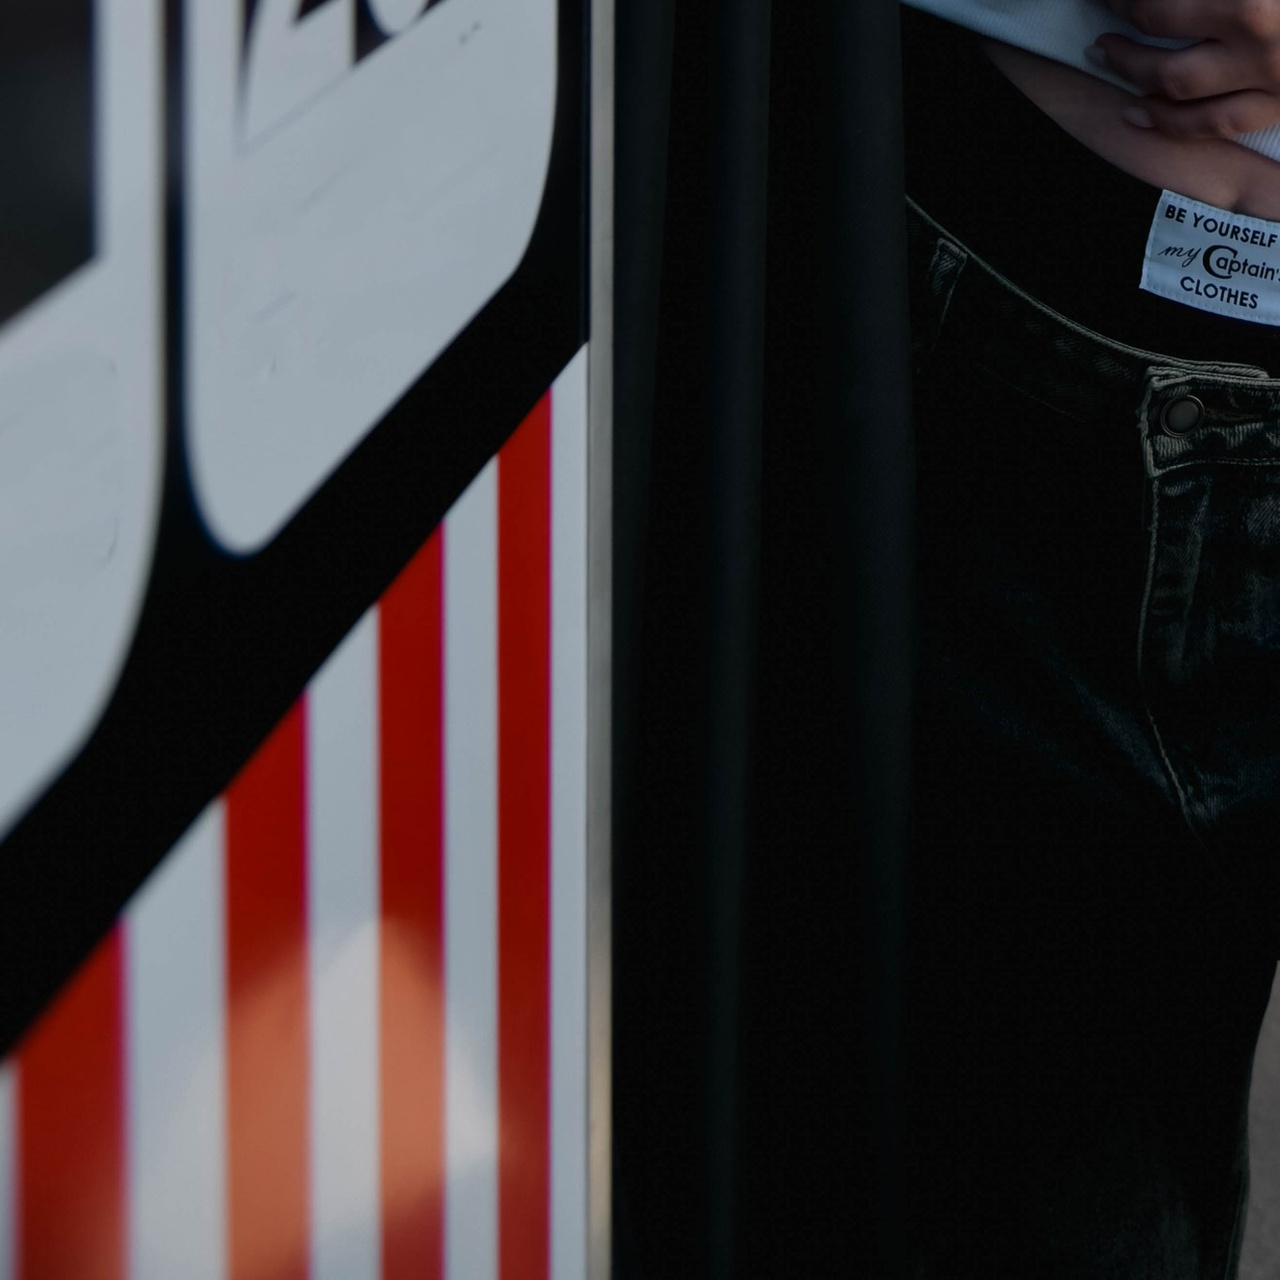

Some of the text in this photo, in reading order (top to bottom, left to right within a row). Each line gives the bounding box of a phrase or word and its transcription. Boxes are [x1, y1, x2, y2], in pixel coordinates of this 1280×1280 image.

[1165, 204, 1187, 223] BE
[1193, 212, 1278, 248] YOURSELF
[1158, 245, 1202, 268] my
[1180, 276, 1259, 309] CLOTHES
